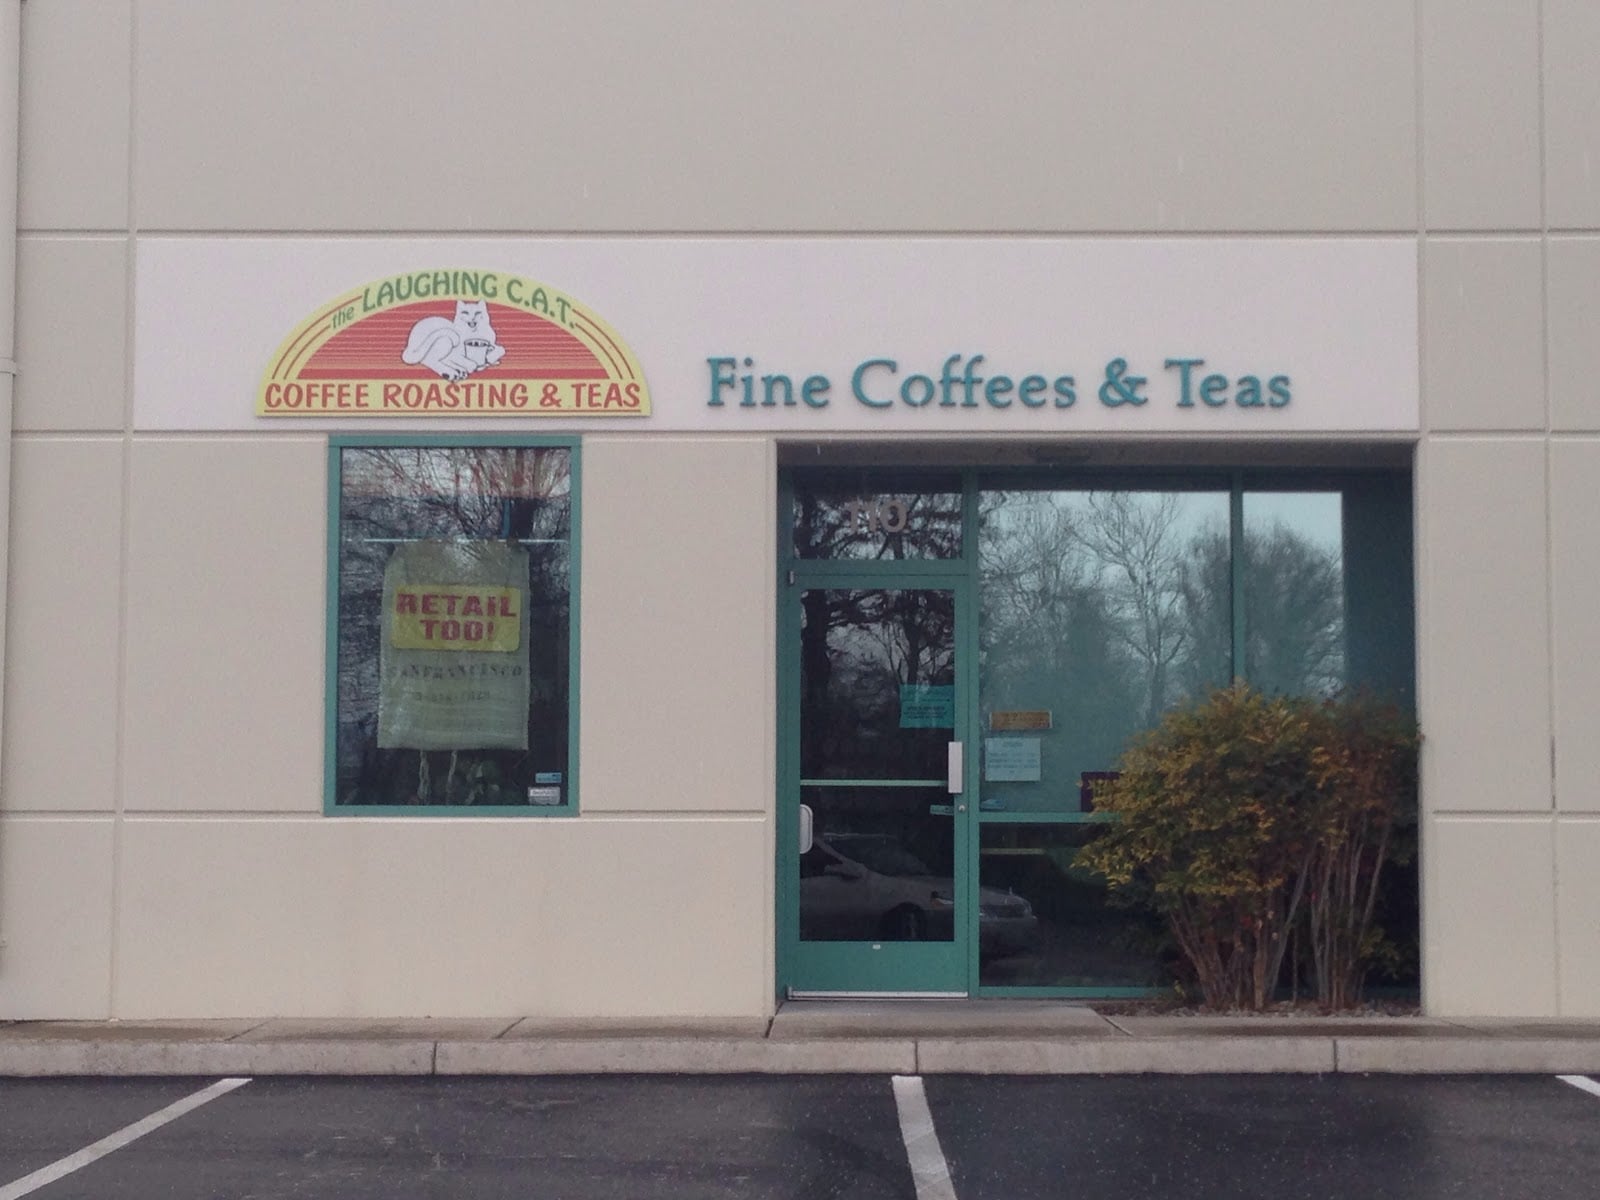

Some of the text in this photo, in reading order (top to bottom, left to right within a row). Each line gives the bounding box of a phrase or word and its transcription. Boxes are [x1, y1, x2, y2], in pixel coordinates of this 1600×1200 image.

[331, 270, 577, 329] the LAUGHING C.A.T.
[706, 353, 1293, 408] Fine Coffees & Teas
[264, 382, 641, 409] COFFEE ROASTING & TEAS
[395, 593, 517, 617] RETAIL
[419, 619, 496, 641] TOO!
